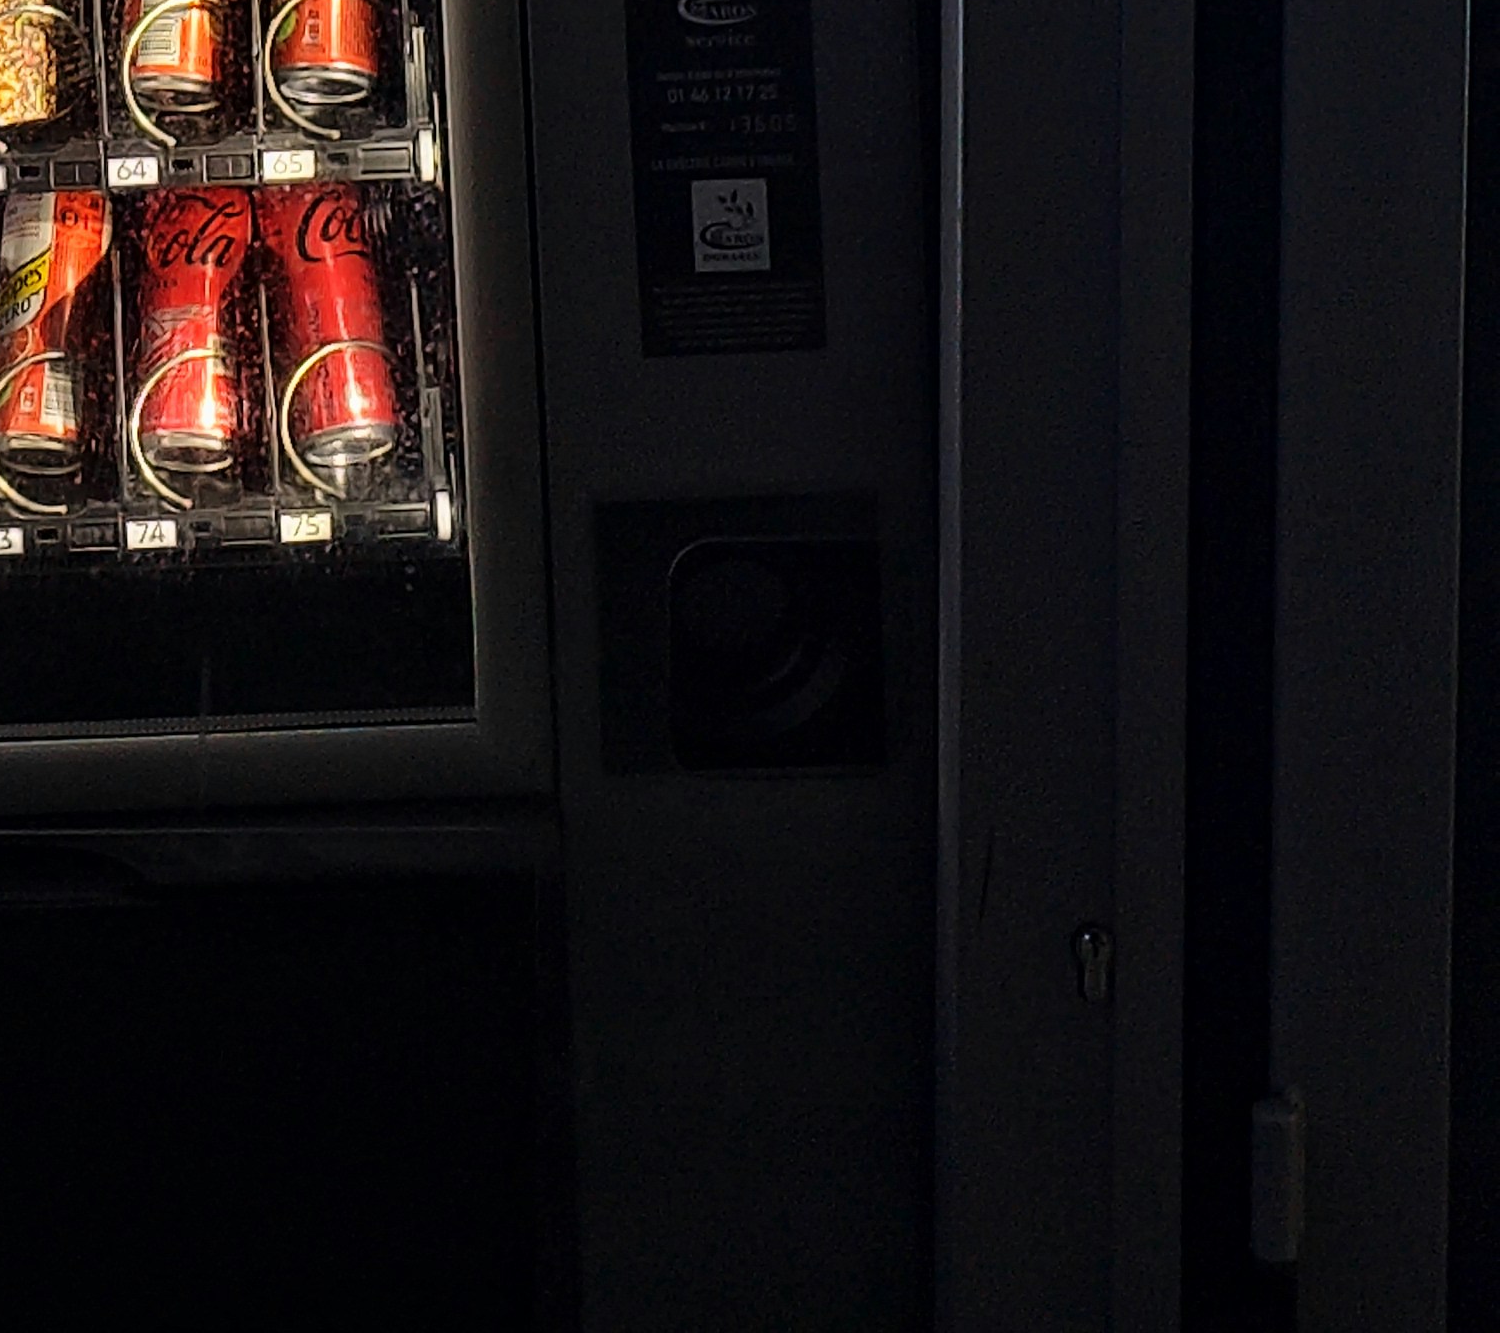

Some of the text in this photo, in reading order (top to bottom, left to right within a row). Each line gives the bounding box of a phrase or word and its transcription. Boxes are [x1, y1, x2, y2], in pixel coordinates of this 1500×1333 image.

[115, 158, 148, 180] 64
[272, 152, 304, 175] 65
[135, 522, 168, 545] 74
[288, 514, 323, 538] 75
